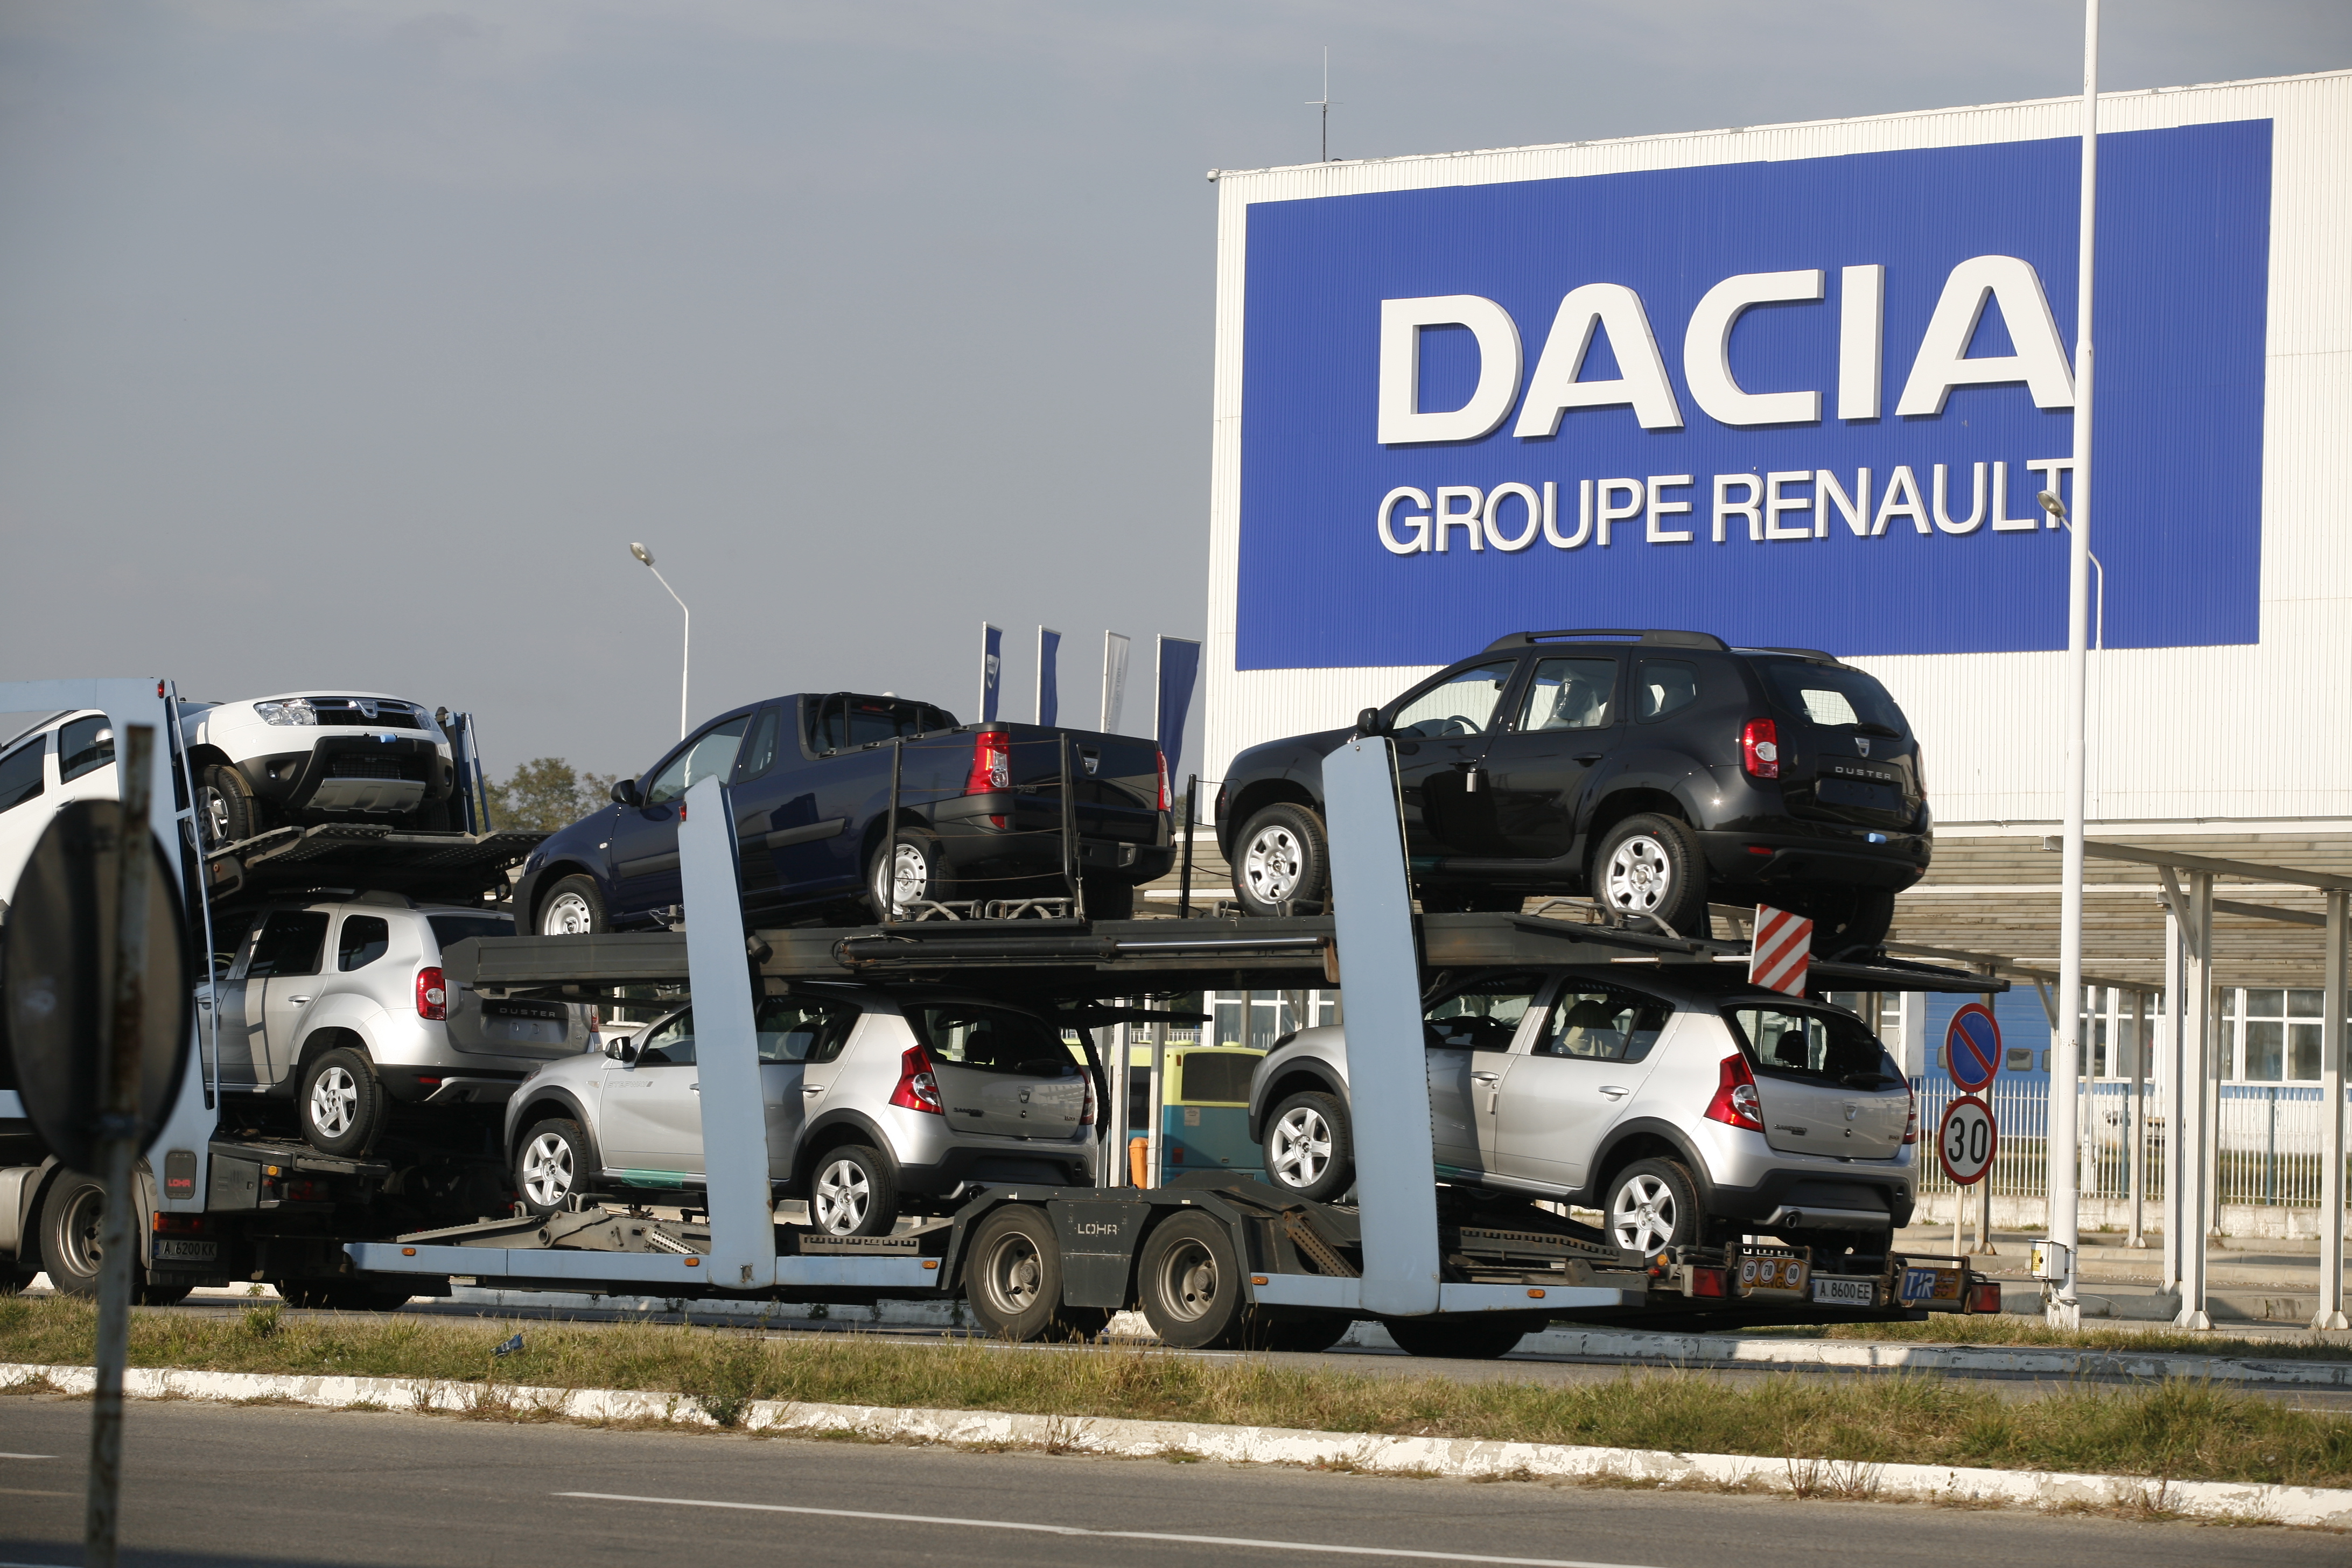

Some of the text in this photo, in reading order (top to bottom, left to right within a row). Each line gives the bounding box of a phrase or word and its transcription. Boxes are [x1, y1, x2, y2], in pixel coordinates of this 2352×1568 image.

[1377, 254, 2075, 446] DACIA
[1377, 458, 2074, 555] GROUPE RENAULT
[1835, 766, 1891, 780] DUSTER
[499, 1007, 556, 1018] DUSTER
[1948, 1117, 1987, 1164] 30
[1077, 1223, 1117, 1235] LOHR
[1746, 1265, 1755, 1277] 50
[1763, 1265, 1773, 1277] 70
[1788, 1268, 1798, 1280] 80
[1907, 1272, 1936, 1298] TIR
